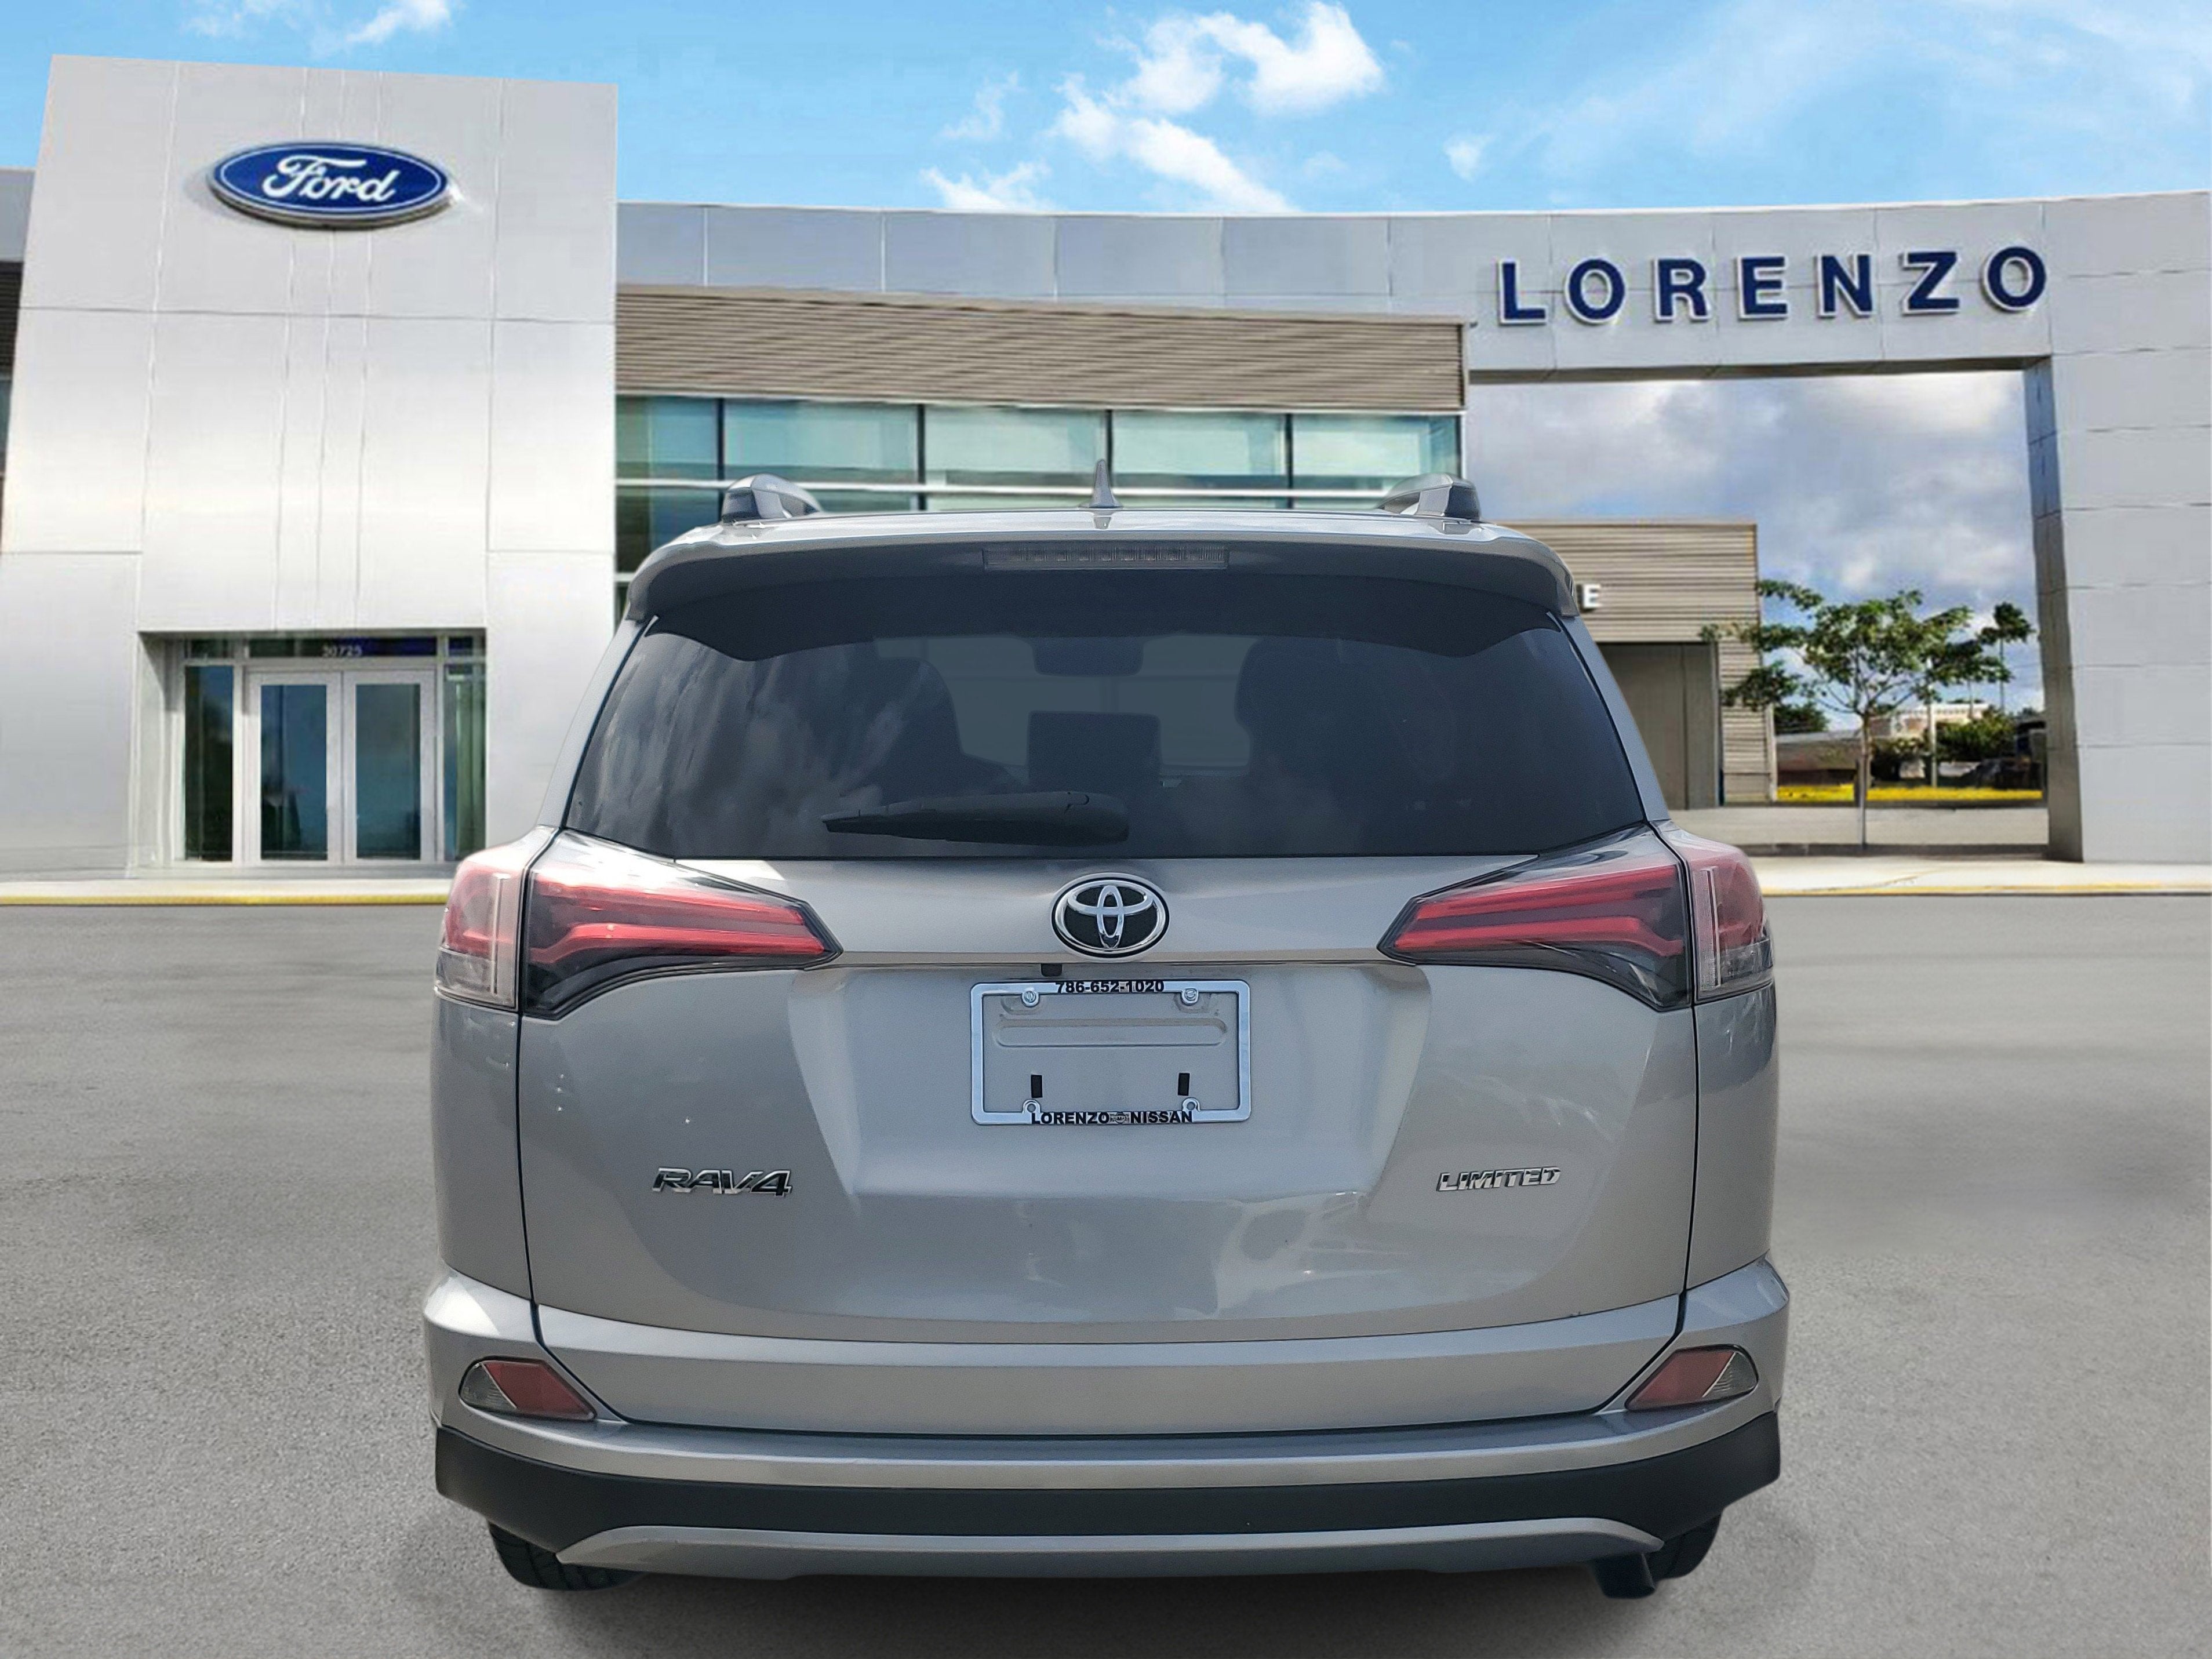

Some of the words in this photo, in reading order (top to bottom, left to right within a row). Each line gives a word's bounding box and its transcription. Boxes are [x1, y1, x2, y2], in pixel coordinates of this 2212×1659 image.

[263, 154, 400, 202] Ford
[1498, 246, 2046, 326] LORENZO
[1055, 980, 1165, 993] 786-652-1020
[1031, 1112, 1109, 1125] LORENZO
[1130, 1111, 1192, 1124] NISSAN
[652, 1167, 792, 1196] RAV4
[1436, 1166, 1562, 1191] LIMITED
